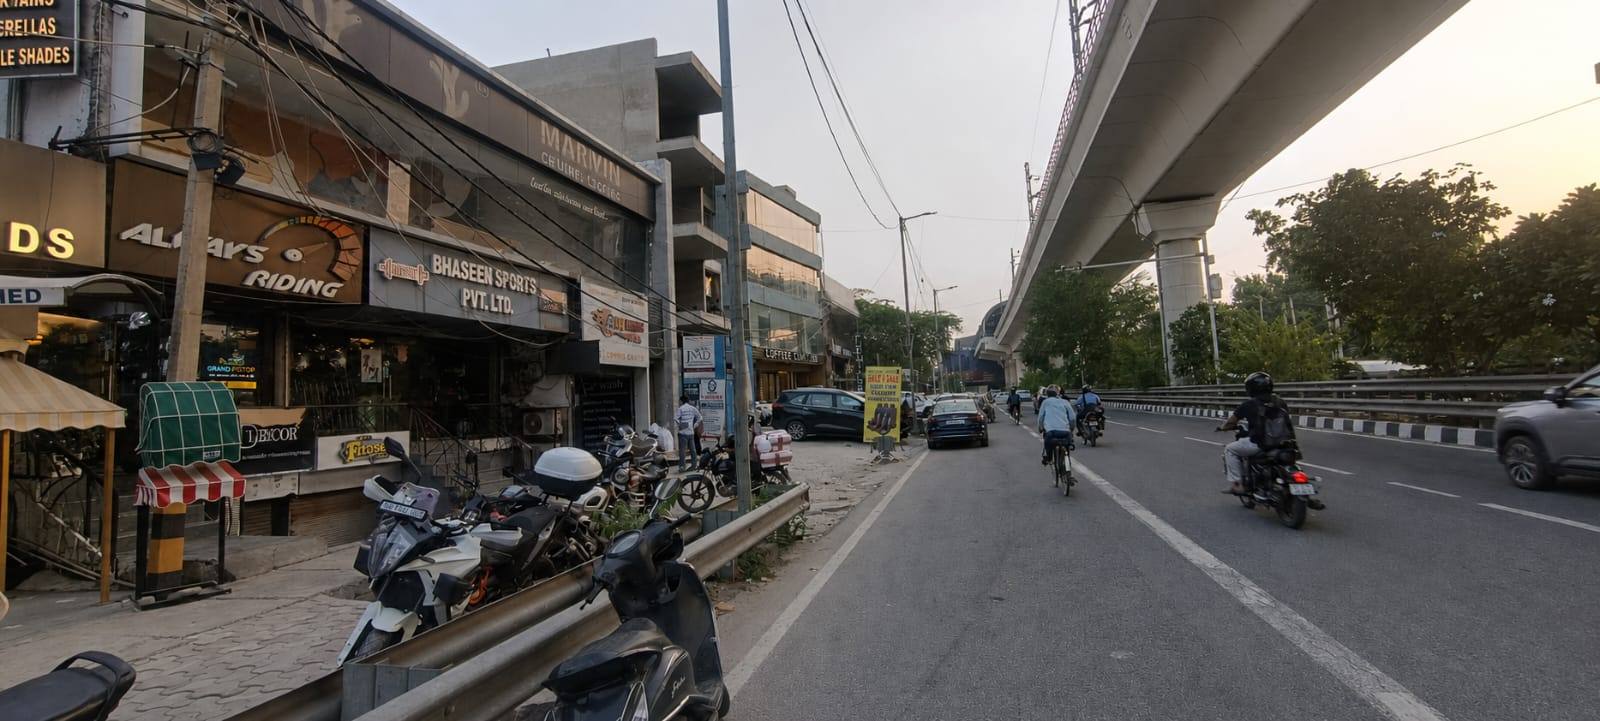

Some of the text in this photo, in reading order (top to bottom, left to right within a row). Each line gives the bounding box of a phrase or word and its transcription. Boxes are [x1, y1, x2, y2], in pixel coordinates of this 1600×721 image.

[18, 46, 70, 65] SHADES
[119, 223, 269, 264] ALAYS
[242, 269, 344, 298] RIDING
[432, 253, 493, 285] BHASEEN
[495, 267, 537, 295] SPORTS
[462, 287, 514, 314] PVT. LTD.
